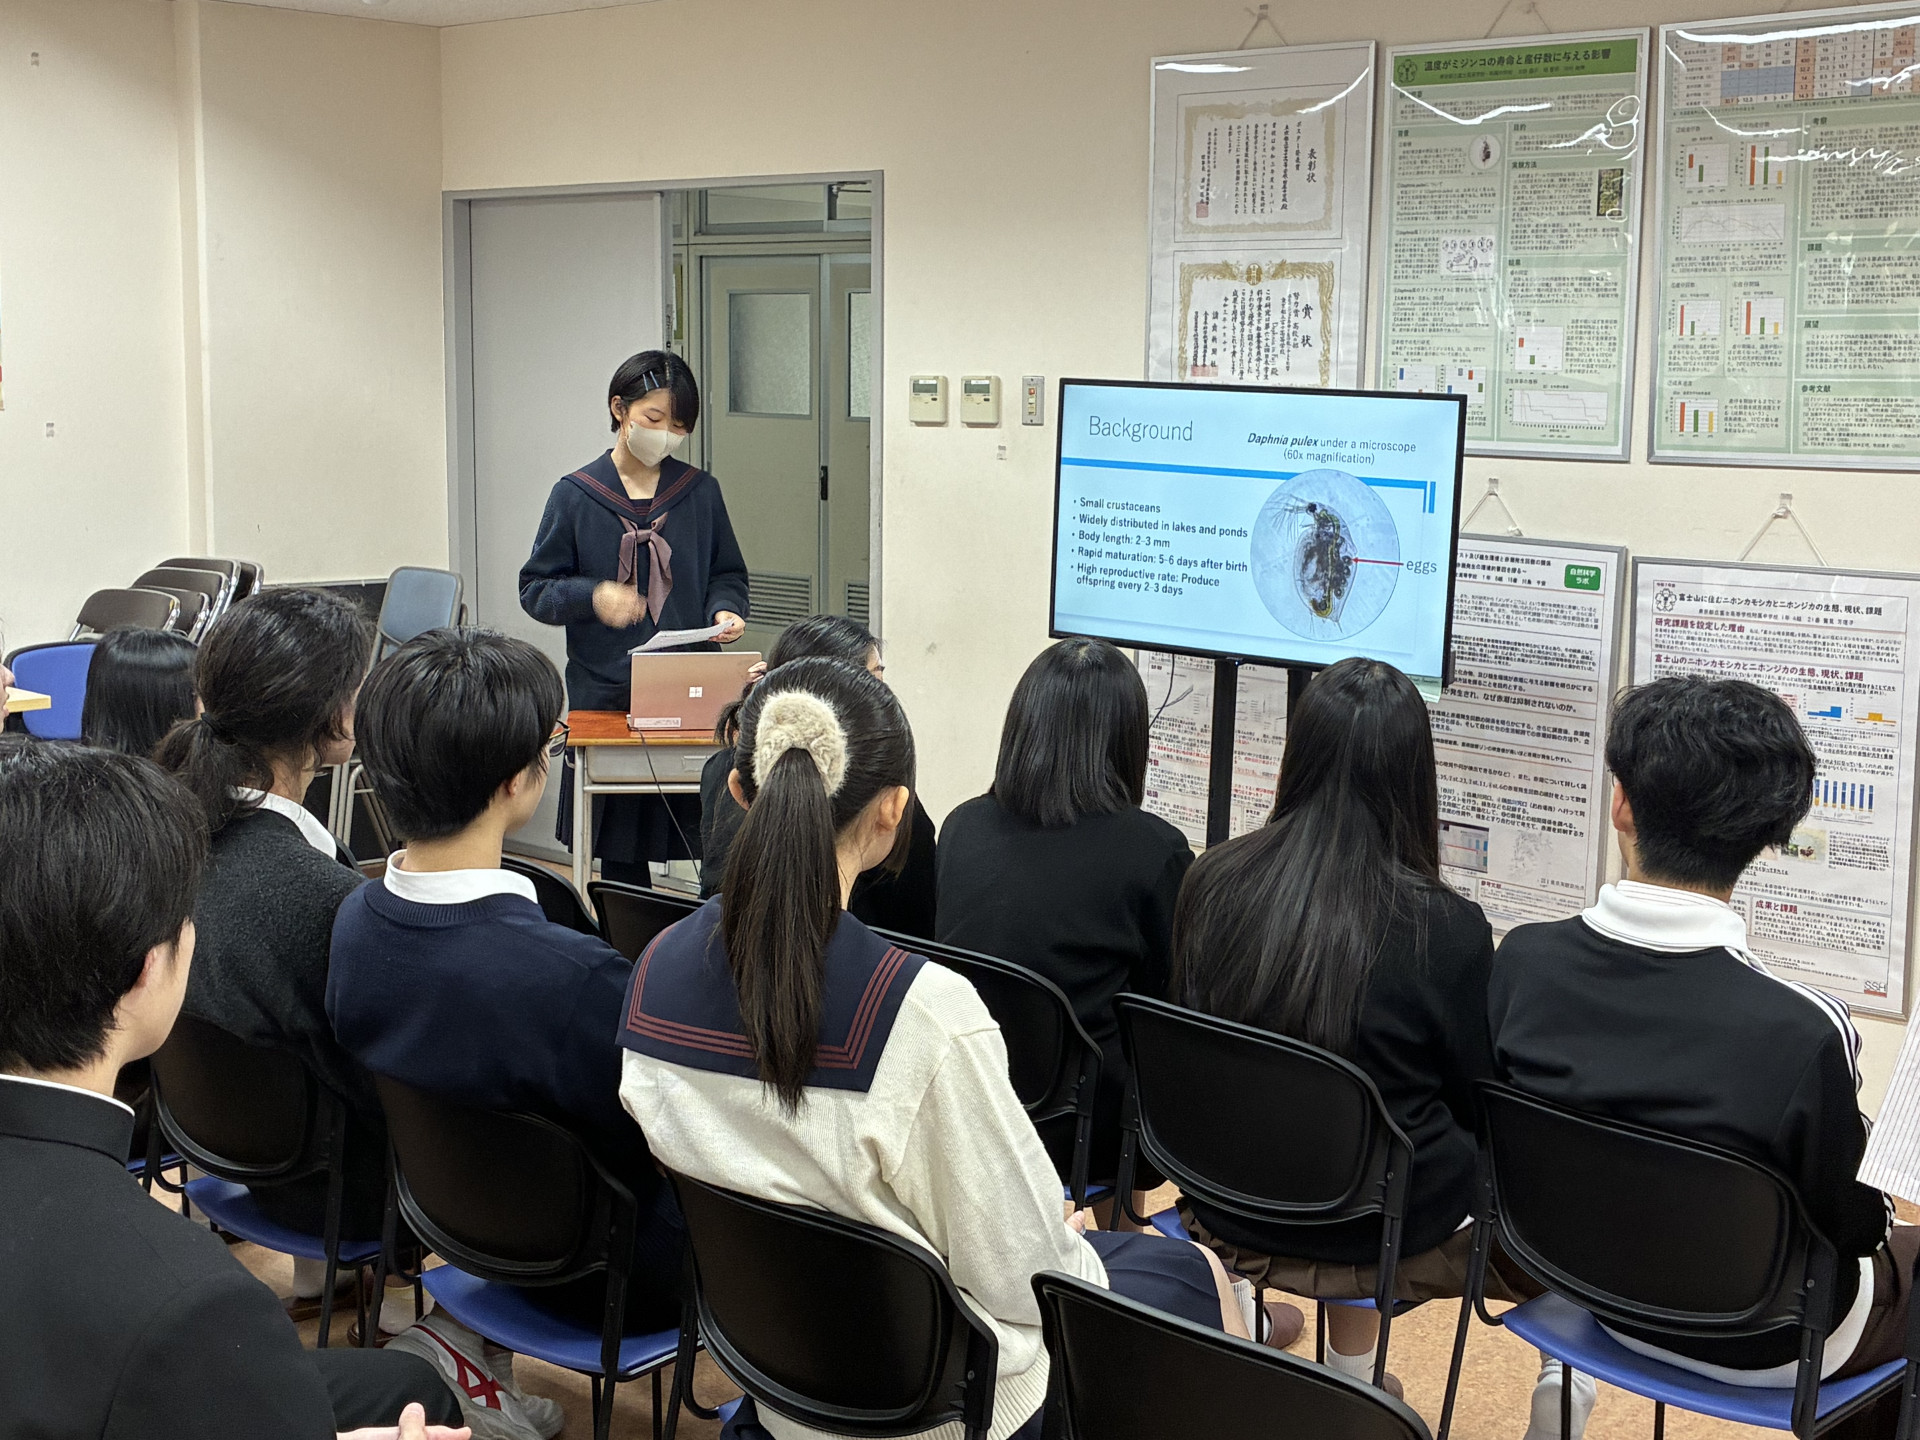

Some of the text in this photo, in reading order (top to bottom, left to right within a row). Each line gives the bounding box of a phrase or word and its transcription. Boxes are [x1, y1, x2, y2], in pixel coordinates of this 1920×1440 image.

[1513, 123, 1526, 131] 目的
[1812, 116, 1828, 125] 考察
[1306, 148, 1318, 183] 表彰状
[1512, 161, 1537, 169] 実験方法
[1804, 320, 1819, 329] 展望
[1801, 384, 1831, 393] 参考文献
[1089, 415, 1193, 443] Background
[1247, 432, 1417, 453] Daphnia pulex under a microscope
[1283, 448, 1375, 466] (60x magnification)
[1080, 497, 1161, 514] Small crustaceans
[1079, 513, 1248, 538] Widely distributed in lakes and ponds
[1078, 530, 1101, 543] Body
[1102, 532, 1134, 546] length:
[1153, 538, 1171, 548] mm
[1077, 546, 1103, 559] Rapid
[1105, 549, 1156, 564] maturation:
[1176, 556, 1198, 569] days
[1200, 558, 1223, 570] after
[1225, 560, 1248, 573] birth
[1406, 561, 1438, 575] eggs
[1077, 562, 1220, 587] High reproductive rate: Produce
[1569, 567, 1597, 578] 自然科学
[1575, 577, 1590, 585] ラボ
[1076, 575, 1116, 590] offspring
[1117, 580, 1142, 593] every
[1161, 584, 1184, 597] days
[1678, 593, 1882, 616] 富士山に住むニホンカモシカとニホンジカの生態、現状、課題
[1655, 617, 1745, 633] 研究課題を設定した理由
[1655, 653, 1864, 681] 富士山のニホンカモシカとニホンジカの生態、現状、課題
[1443, 687, 1577, 713] が発生され、なぜ赤潮は抑制されないのか。
[1755, 899, 1798, 915] 成果と課題
[1864, 980, 1887, 992] SSH
